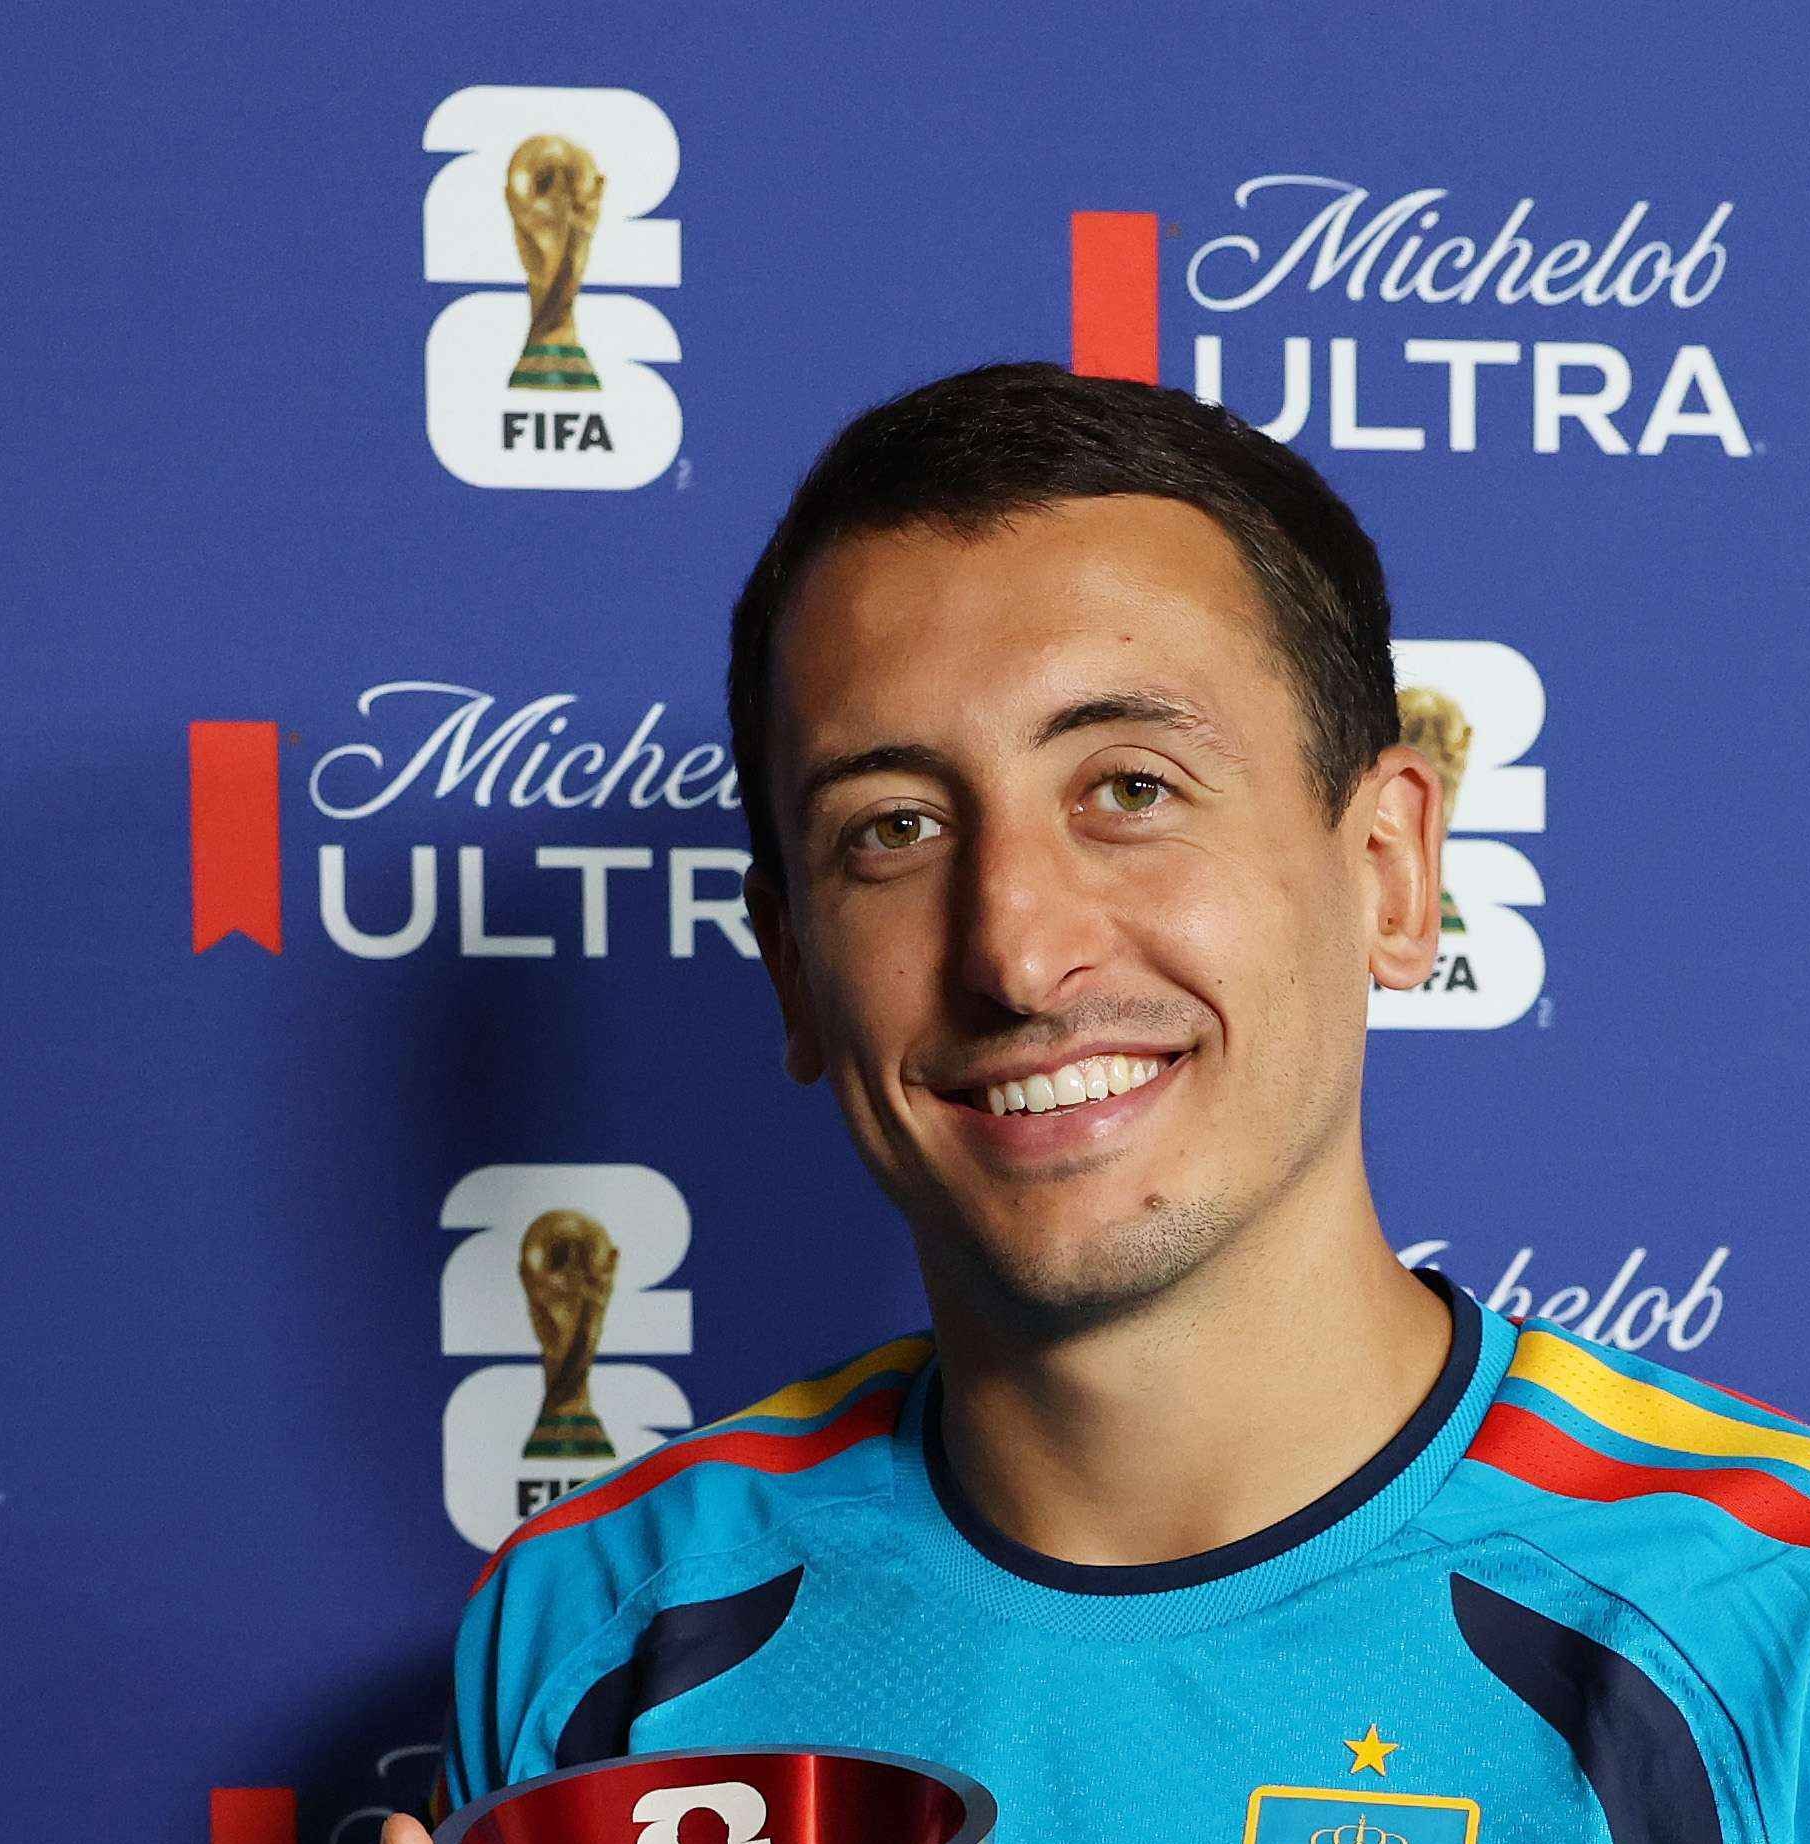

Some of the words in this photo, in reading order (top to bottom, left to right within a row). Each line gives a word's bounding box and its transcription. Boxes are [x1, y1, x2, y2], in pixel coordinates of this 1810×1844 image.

[1187, 175, 1733, 311] Michelob
[503, 412, 613, 452] FIFA
[1194, 335, 1752, 458] ULTRA
[309, 680, 741, 820] Miche
[318, 844, 762, 959] ULTR
